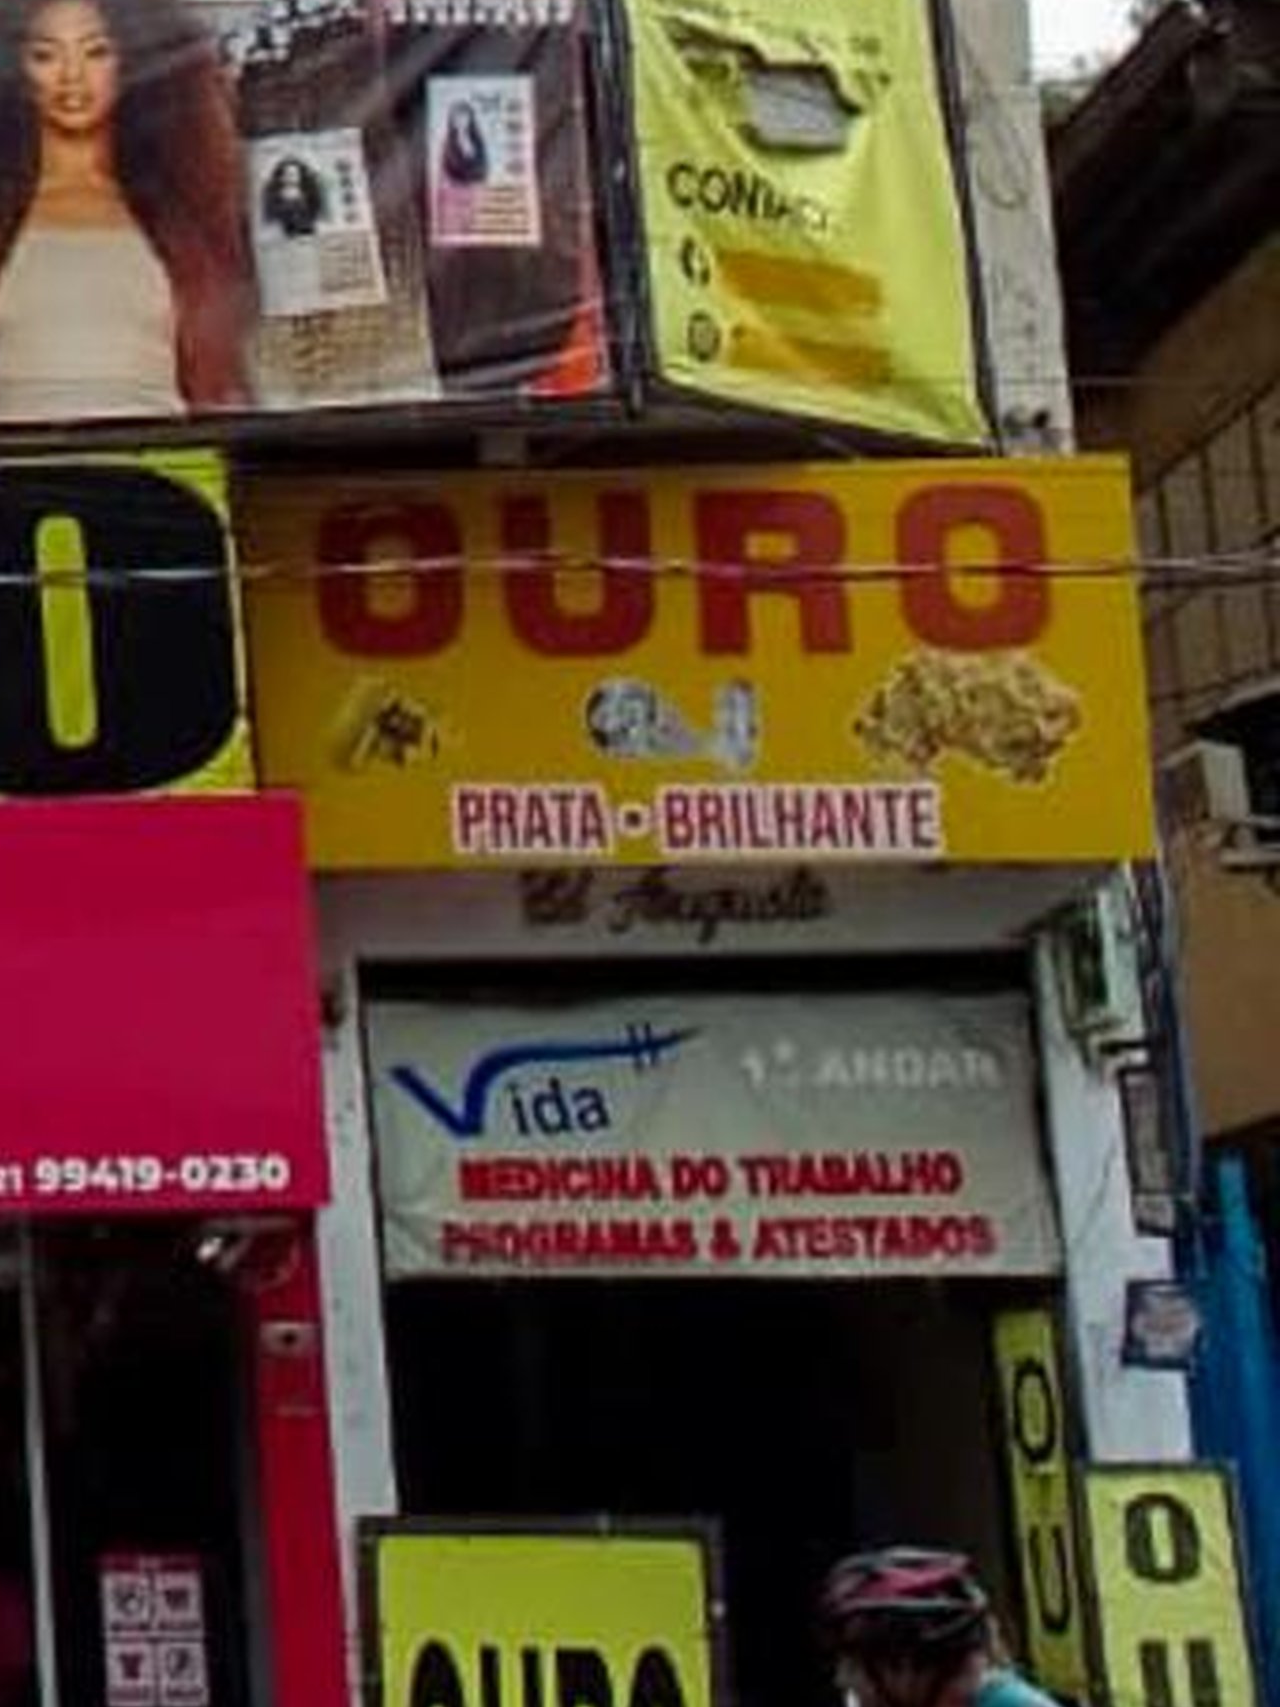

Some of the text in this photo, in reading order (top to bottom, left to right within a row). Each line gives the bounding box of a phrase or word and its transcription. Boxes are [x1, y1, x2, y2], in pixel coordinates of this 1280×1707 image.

[315, 482, 1054, 660] OURO
[456, 787, 940, 851] PRATA BRILHANTE
[390, 1026, 702, 1139] Vida
[812, 1045, 1002, 1087] ANDAR
[35, 1153, 290, 1193] 99419-0230
[458, 1149, 964, 1202] MEDICINA DO TRABALHO
[441, 1217, 697, 1265] PROGRAMAS
[753, 1214, 999, 1261] ATESTADOS
